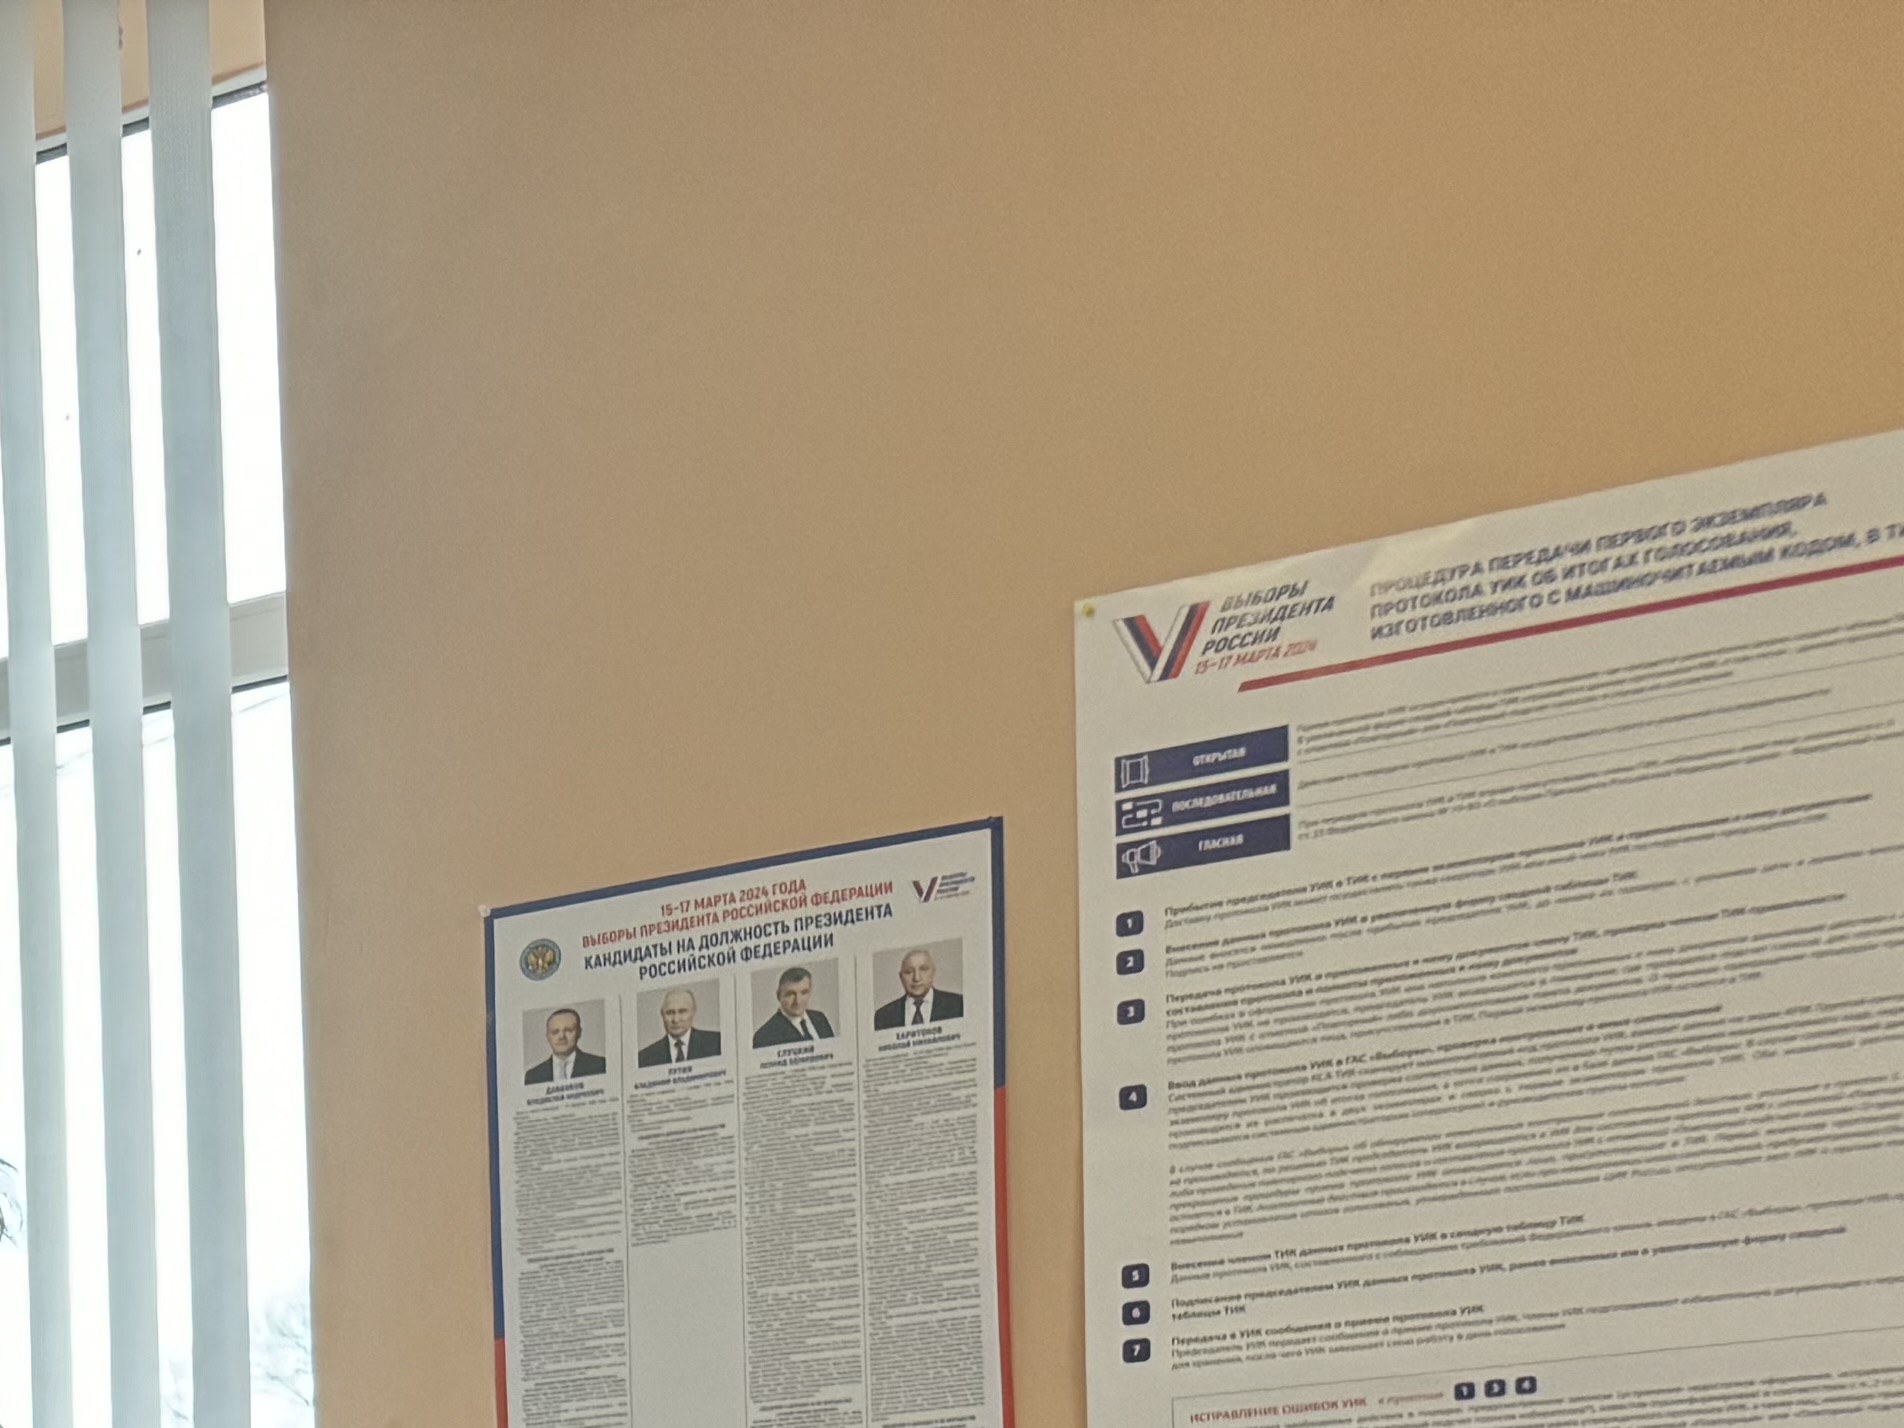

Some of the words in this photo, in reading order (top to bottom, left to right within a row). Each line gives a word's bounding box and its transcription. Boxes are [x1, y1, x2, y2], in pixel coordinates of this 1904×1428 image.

[1369, 561, 1484, 597] ПРОЦЕДУРА
[1488, 539, 1592, 571] ПЕРЕДАЧИ
[1596, 519, 1686, 551] ПЕРВОГО
[1689, 492, 1827, 532] ЭКЗЕМПЛЯРА
[1220, 580, 1308, 613] ВЫБОРЫ
[1369, 584, 1483, 620] ПРОТОКОЛА
[1490, 575, 1527, 594] УИК
[1531, 569, 1558, 586] ОБ
[1562, 551, 1638, 580] ИТОГАХ
[1370, 593, 1544, 640] ИЗГОТОВЛЕННОГО
[1547, 590, 1561, 605] С
[1866, 527, 1880, 544] В
[1211, 596, 1336, 635] ПРЕЗИДЕНТА
[1202, 627, 1281, 656] РОССИИ
[1233, 648, 1280, 667] МАРТА
[1283, 640, 1318, 658] 2024
[1192, 747, 1246, 766] ОТКРЫТАЯ
[1172, 783, 1277, 813] ПОСЛЕДОВАТЕЛЬНАЯ
[1198, 834, 1244, 851] ГЛАСНАЯ
[694, 892, 736, 911] МАРТА
[739, 886, 769, 902] 2024
[772, 879, 806, 897] ГОДА
[582, 928, 637, 948] ВЫБОРЫ
[640, 914, 719, 938] ПРЕЗИДЕНТА
[722, 893, 808, 922] РОССИЙСКОЙ
[811, 881, 893, 907] ФЕДЕРАЦИИ
[584, 940, 672, 970] КАНДИДАТЫ
[677, 936, 695, 953] НА
[698, 920, 790, 951] ДОЛЖНОСТЬ
[794, 902, 893, 931] ПРЕЗИДЕНТА
[639, 948, 736, 980] РОССИЙСКОЙ
[740, 933, 834, 961] ФЕДЕРАЦИИ
[1190, 1405, 1280, 1423] ИСПРАВЛЕНИЕ
[1282, 1400, 1340, 1414] ОШИБОК
[1342, 1397, 1368, 1410] УИК
